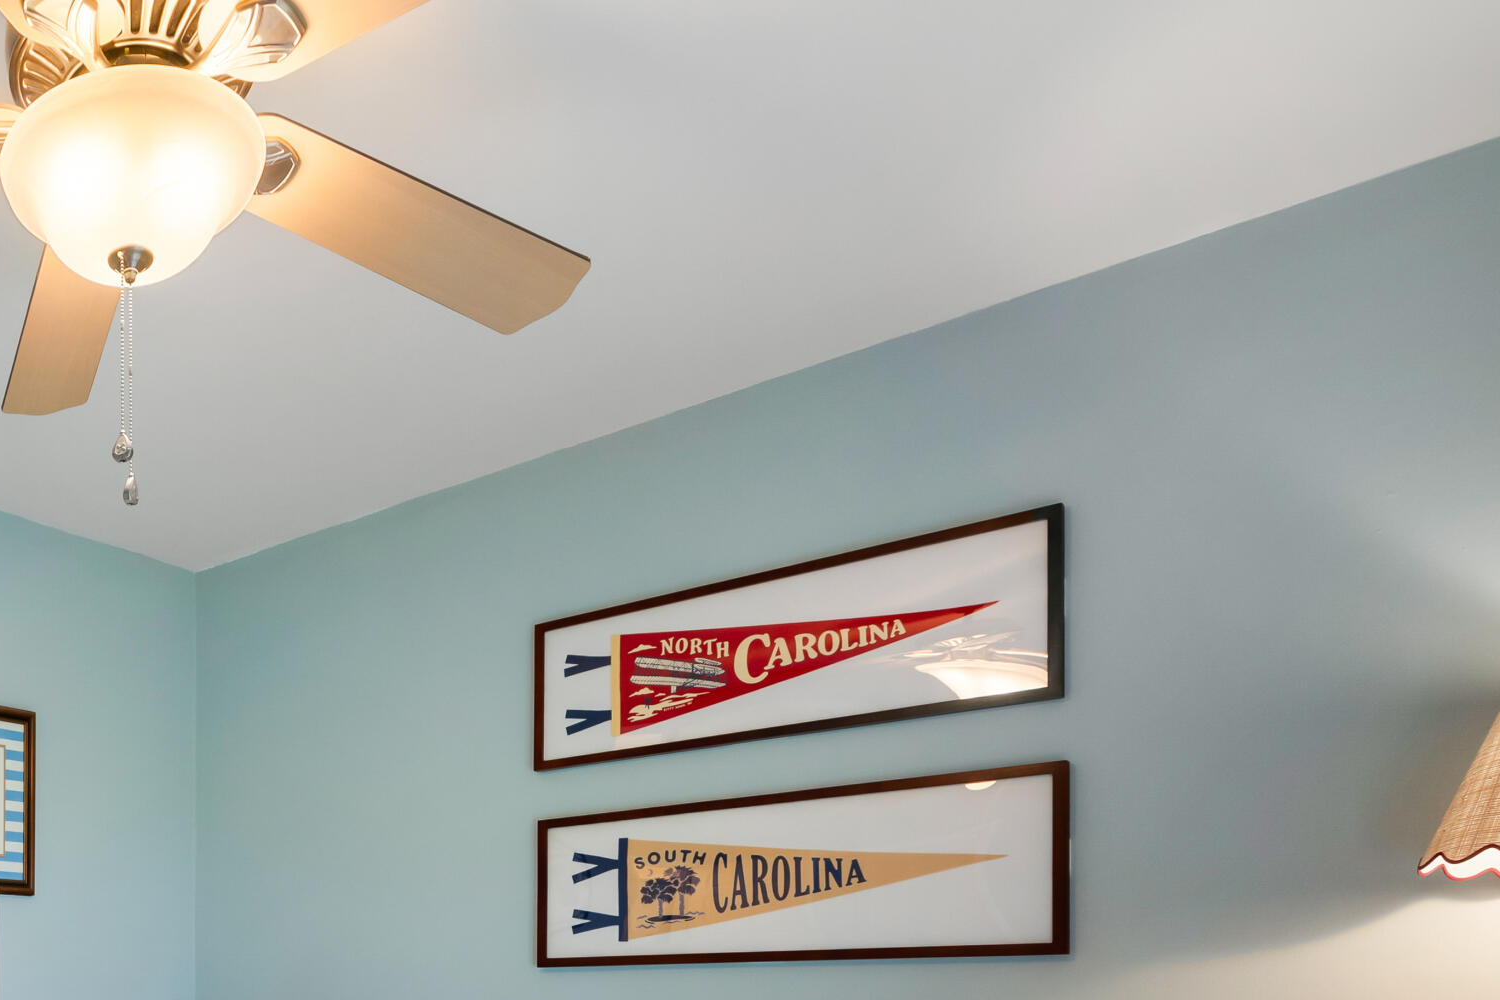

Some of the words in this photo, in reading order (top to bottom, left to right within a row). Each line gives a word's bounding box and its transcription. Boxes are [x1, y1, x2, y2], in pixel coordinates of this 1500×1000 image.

[660, 636, 730, 659] NORTH
[733, 618, 907, 685] CAROLINA
[633, 849, 707, 871] SOUTH
[712, 852, 867, 914] CAROLINA
